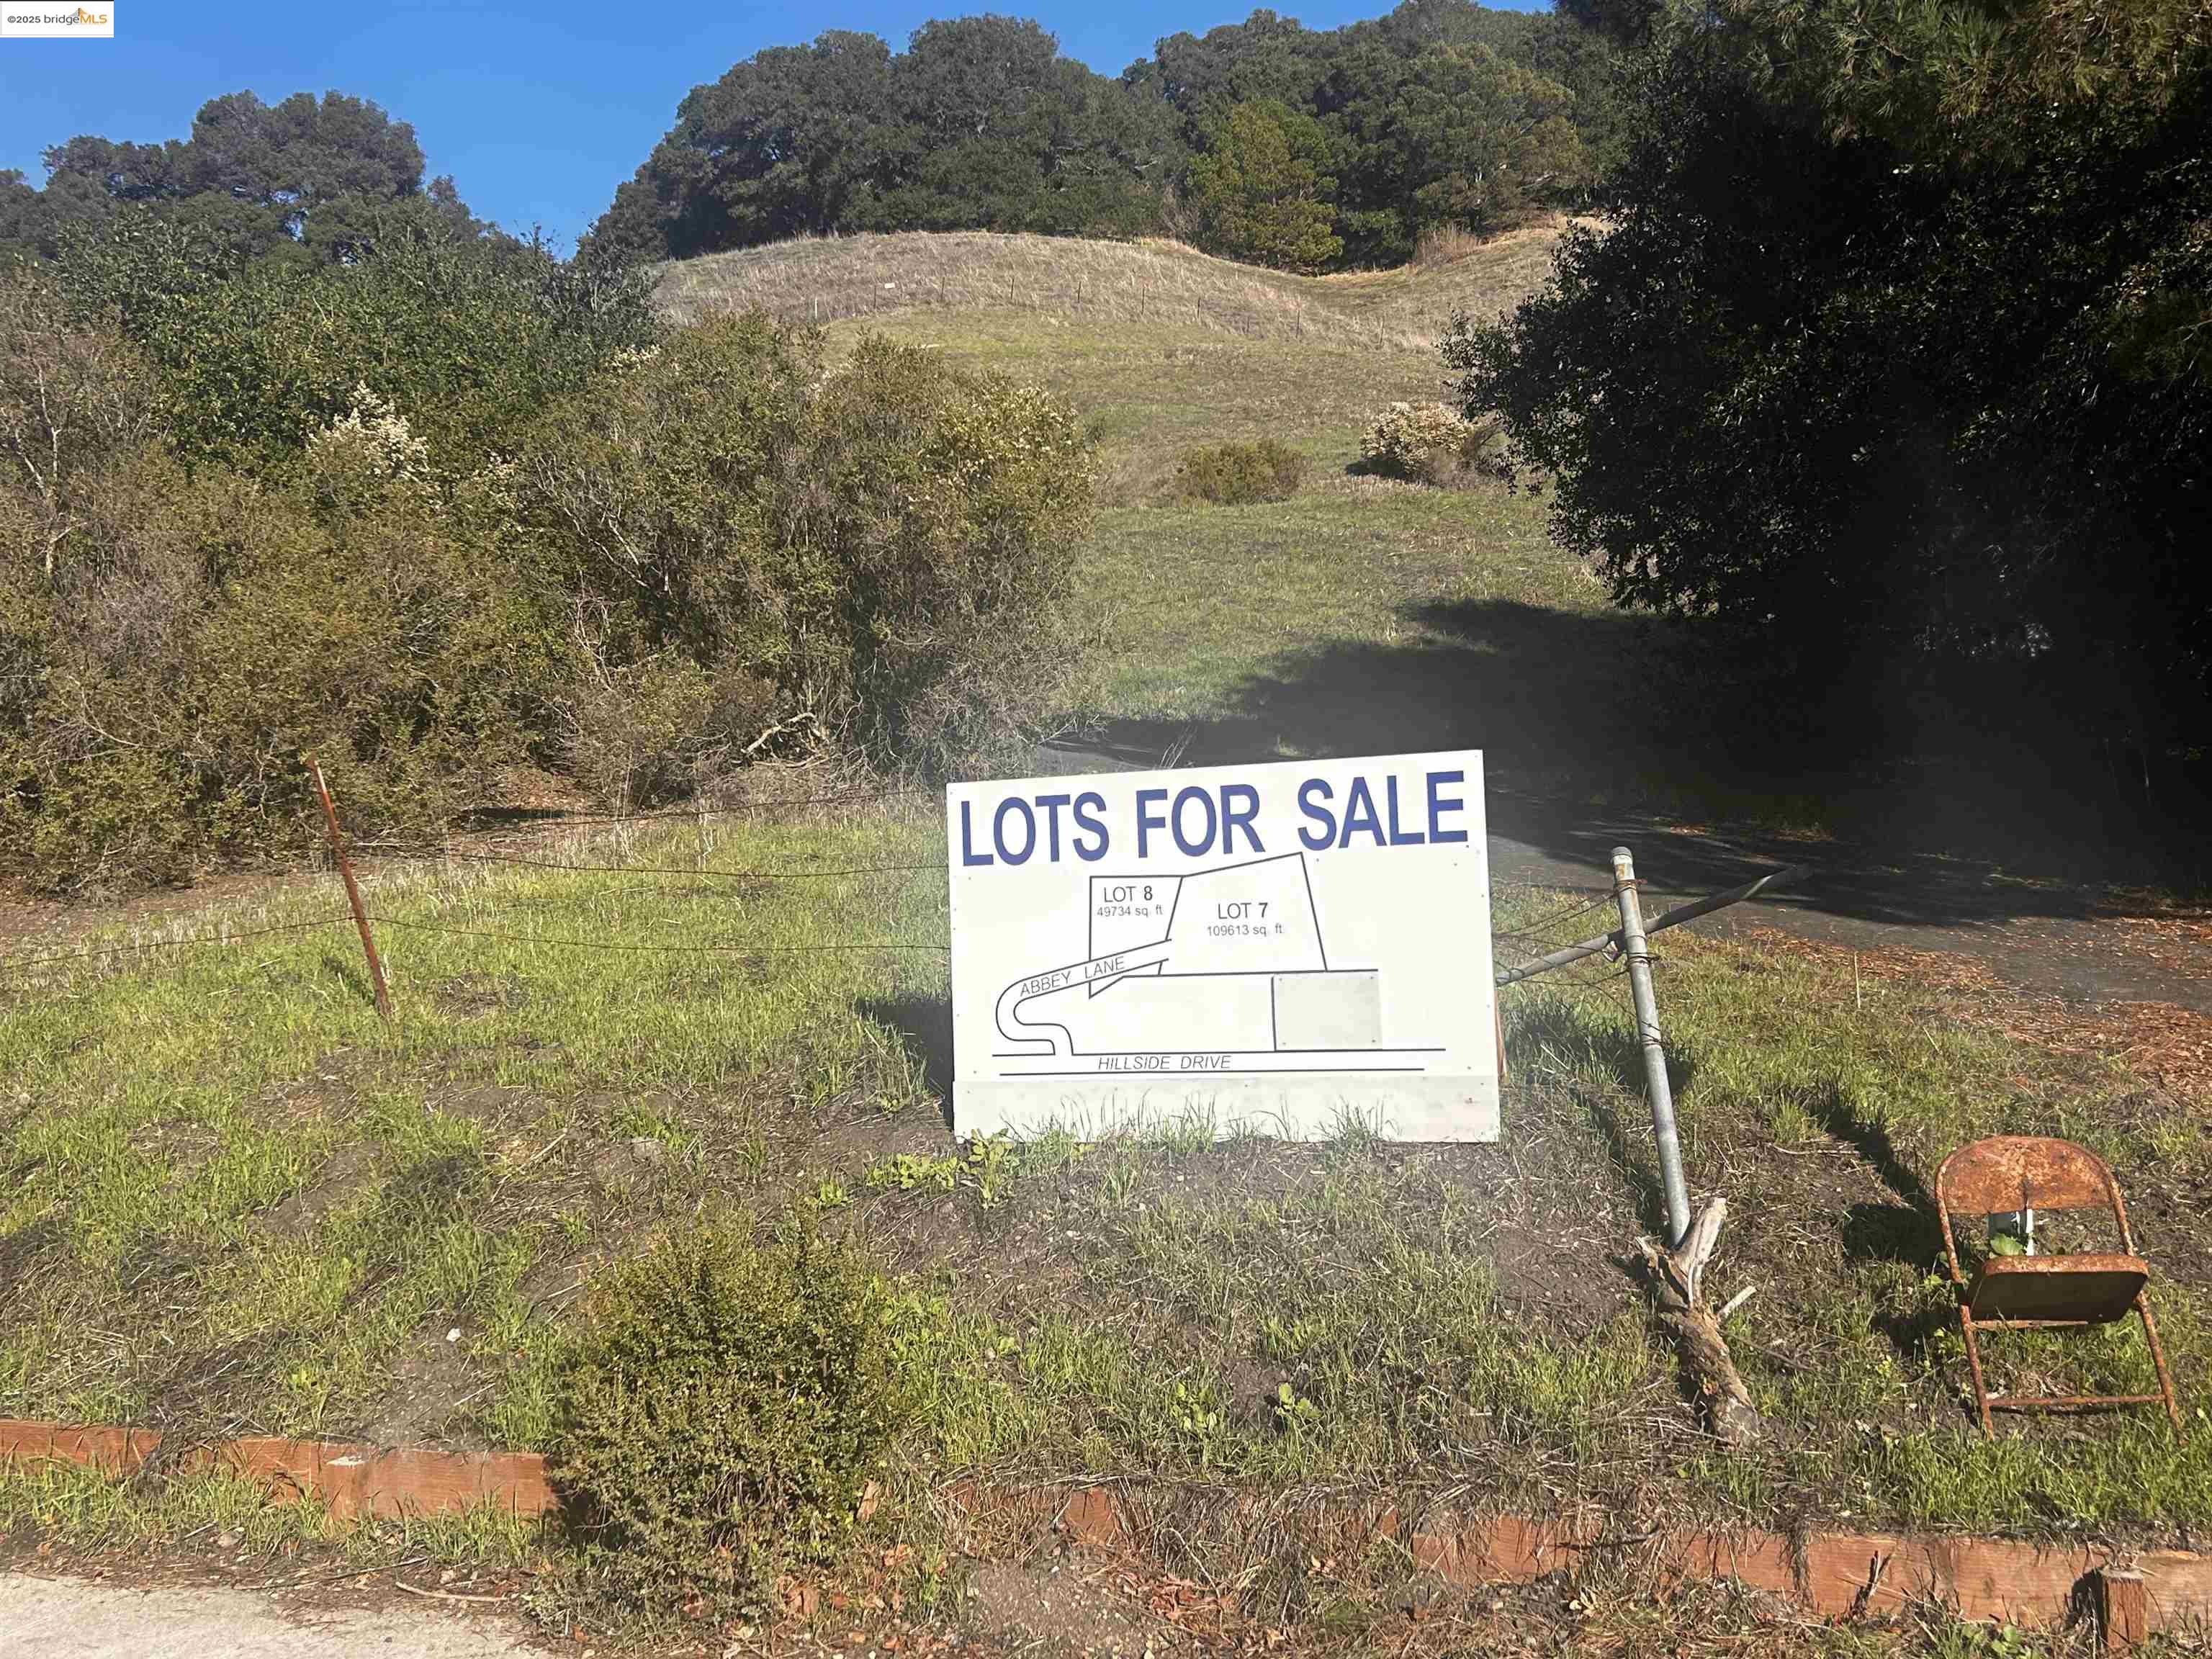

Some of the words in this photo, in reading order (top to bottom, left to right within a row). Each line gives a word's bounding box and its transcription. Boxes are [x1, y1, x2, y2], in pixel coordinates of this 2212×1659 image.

[961, 791, 1110, 866] LOTS
[1136, 783, 1265, 858] FOR
[1297, 770, 1469, 851] SALE
[1104, 886, 1136, 902] LOT
[1143, 885, 1153, 901] 8
[1097, 906, 1130, 917] 49734
[1218, 902, 1251, 919] LOT
[1259, 902, 1268, 917] 7
[1208, 925, 1249, 936] 109613
[1020, 971, 1071, 997] ABBEY
[1084, 956, 1125, 979] LANE
[1098, 1056, 1172, 1070] HILLSIDE
[1180, 1055, 1232, 1069] DRIVE
